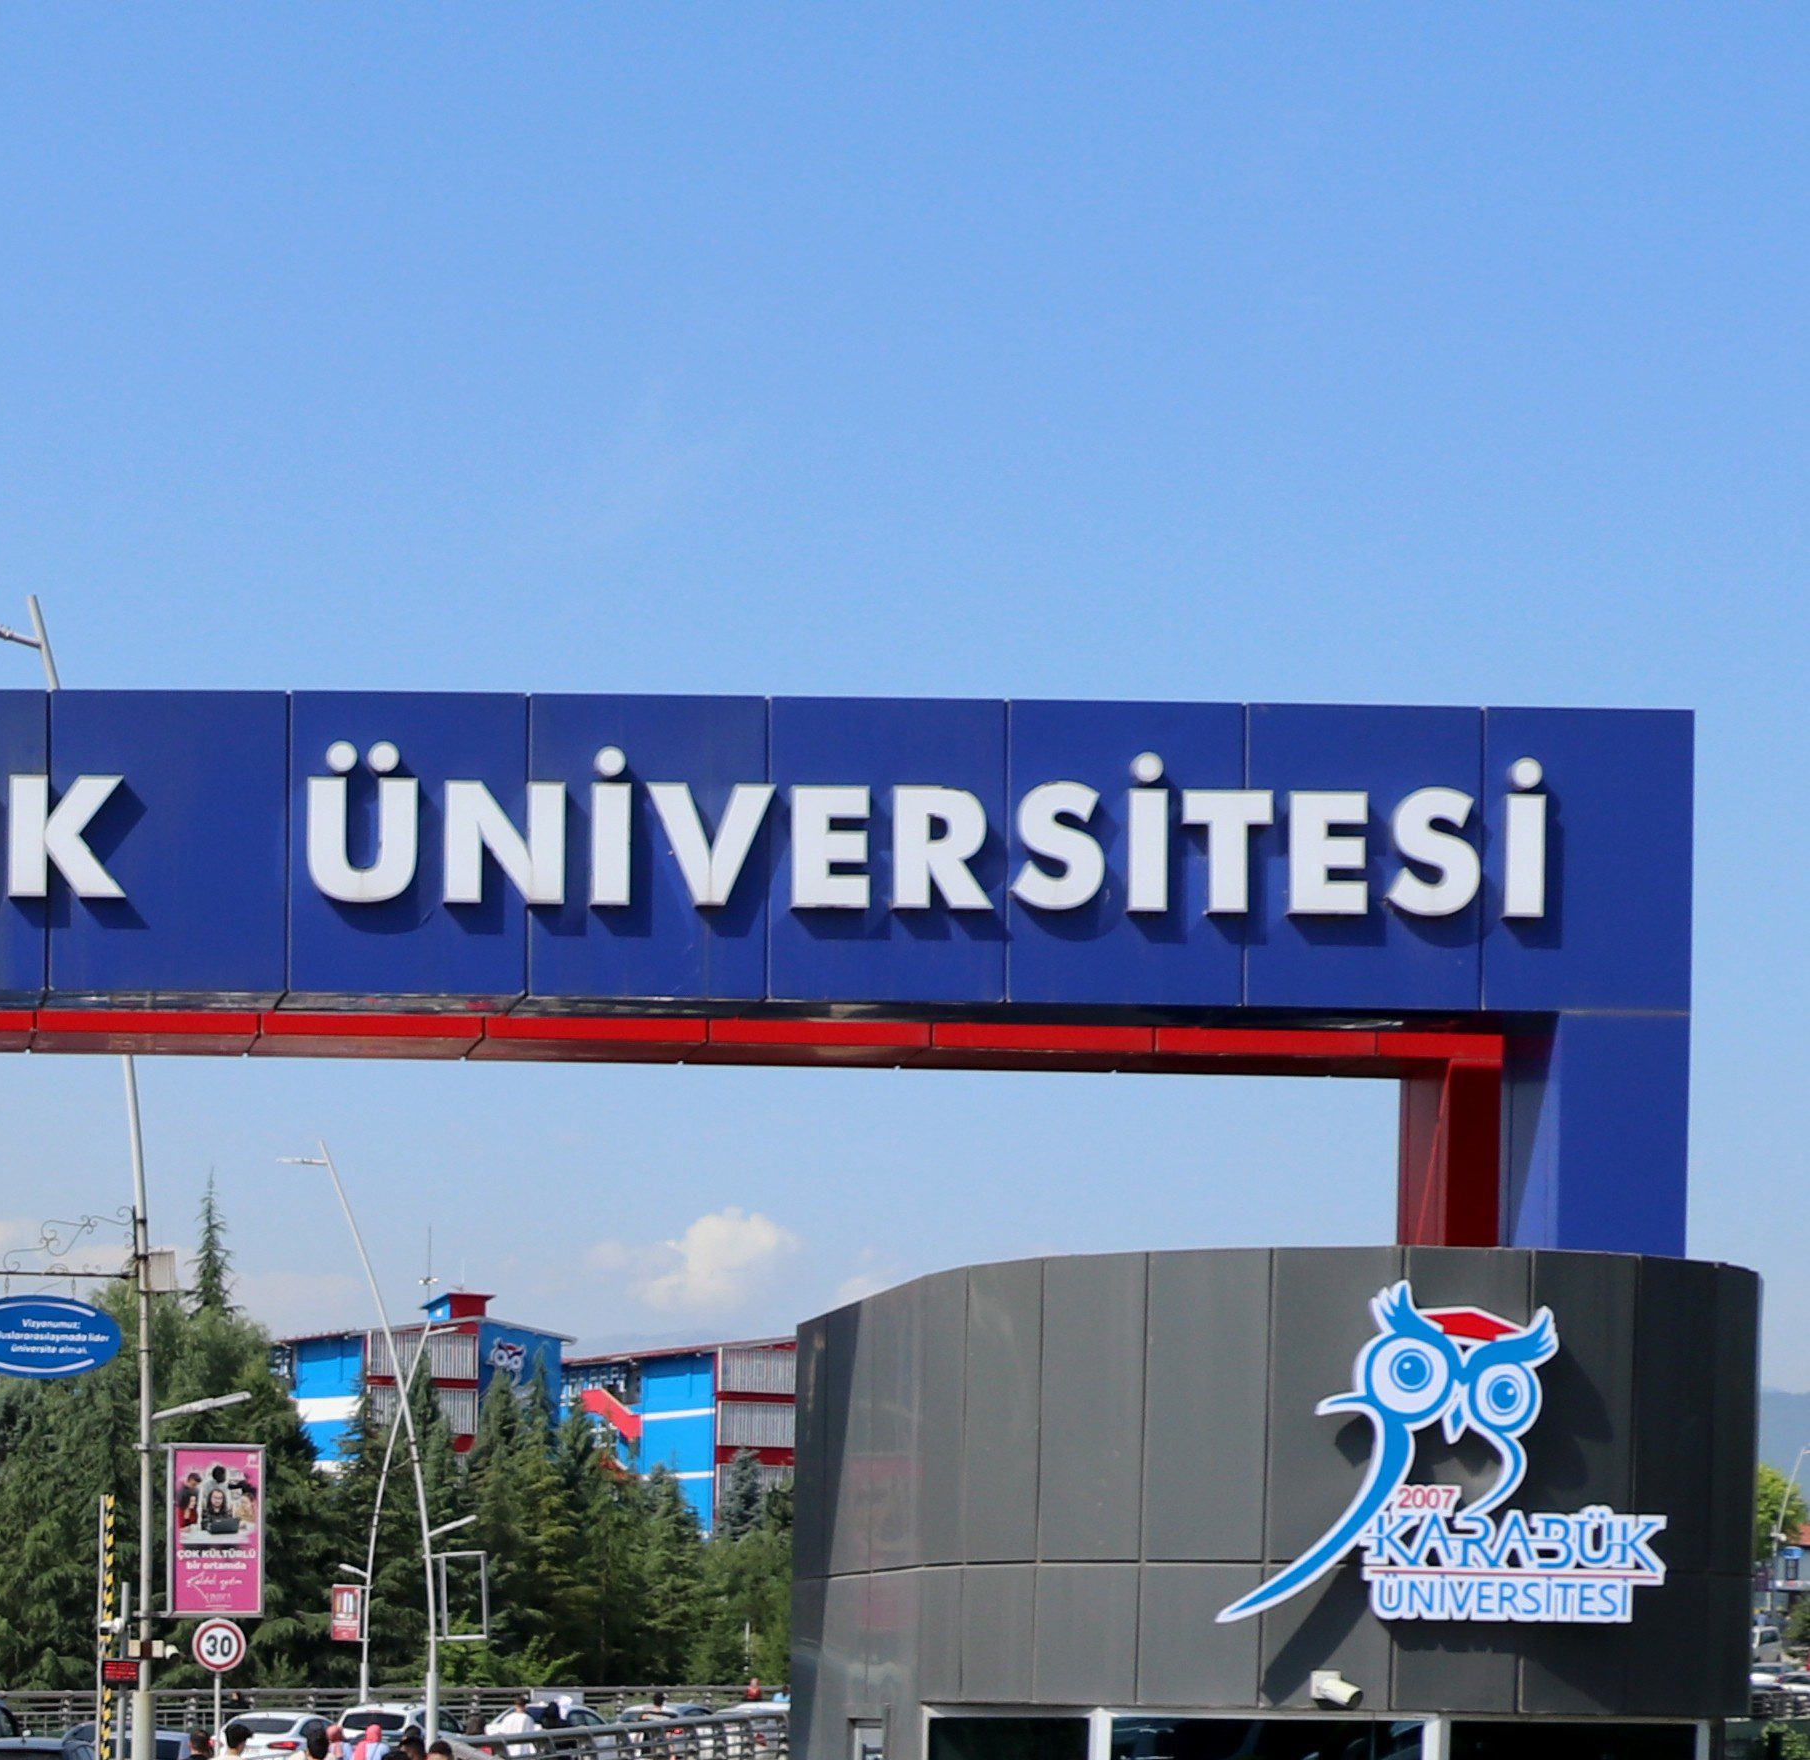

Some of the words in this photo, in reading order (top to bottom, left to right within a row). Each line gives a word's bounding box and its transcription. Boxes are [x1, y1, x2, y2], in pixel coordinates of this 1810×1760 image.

[305, 740, 1547, 918] ÜNİVERSİTESİ
[1398, 1487, 1456, 1509] 2007
[1365, 1511, 1660, 1573] KARABÜK
[1379, 1573, 1630, 1617] ÜNİVERSİTESİ
[205, 1634, 233, 1657] 30
